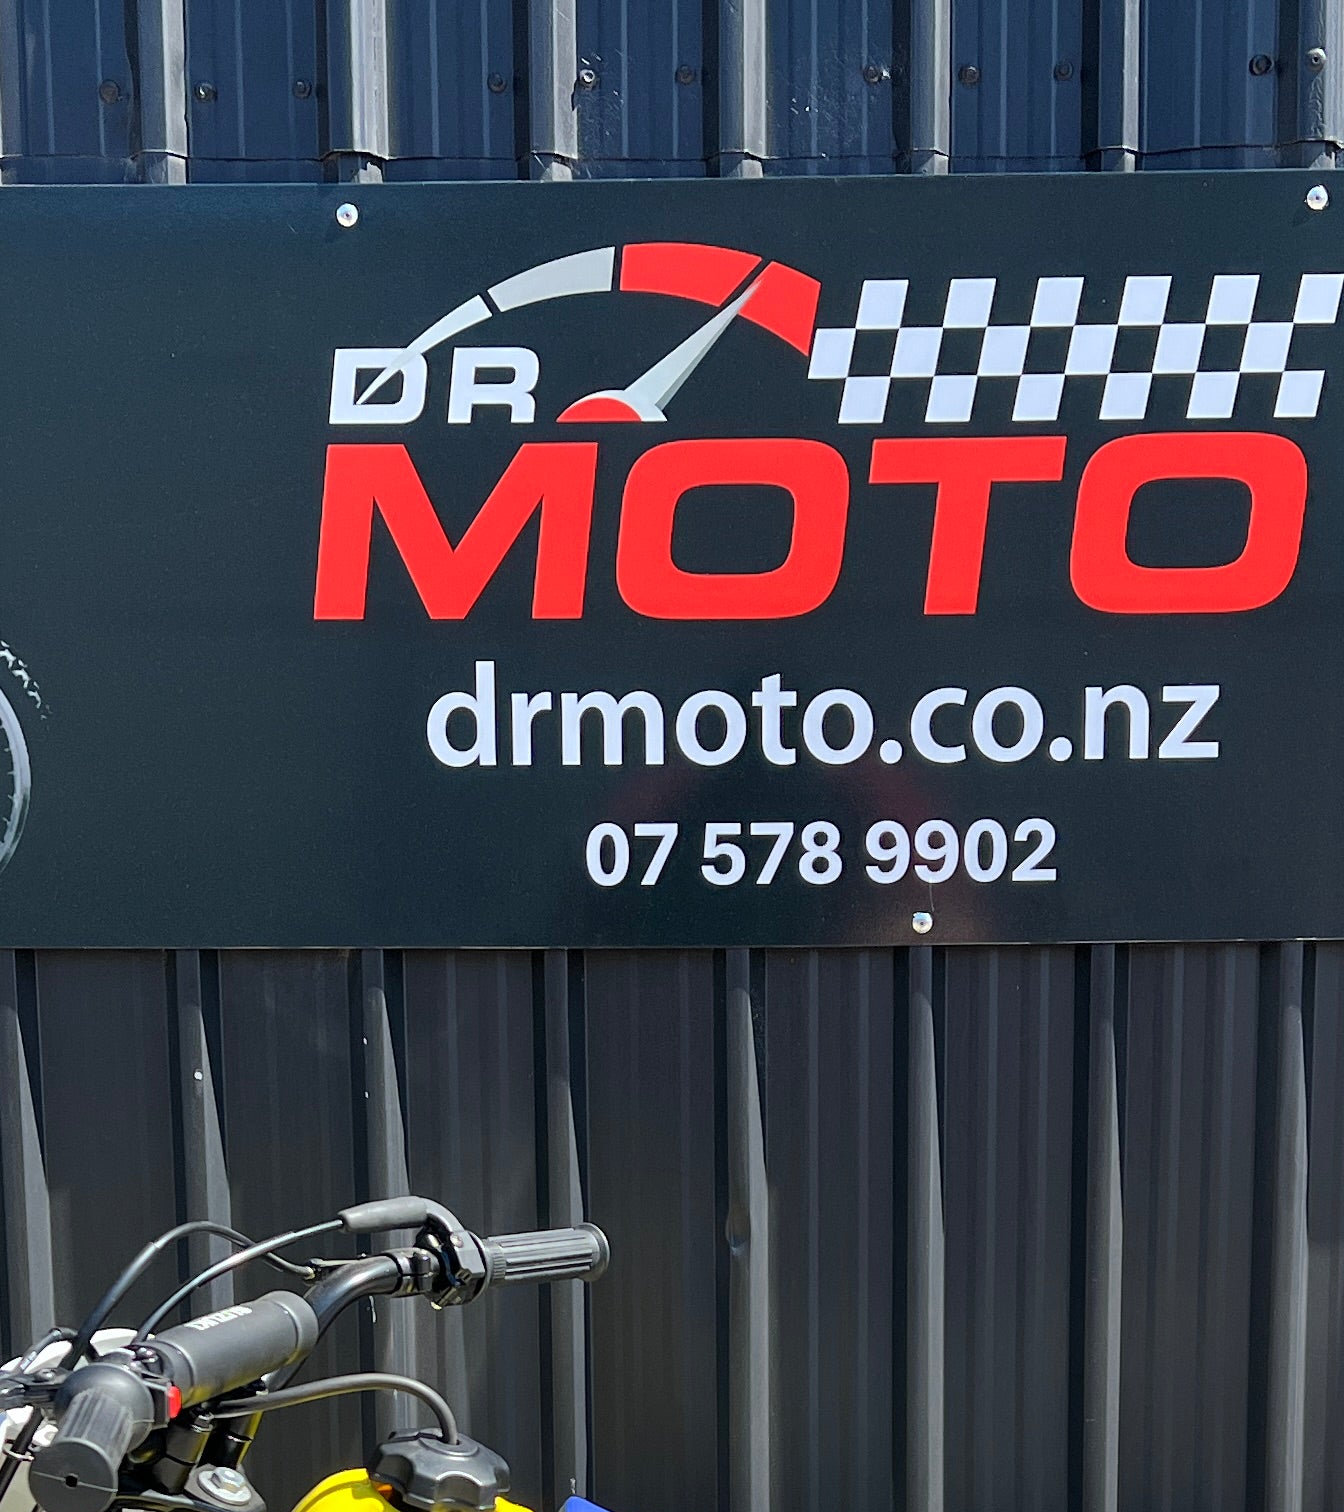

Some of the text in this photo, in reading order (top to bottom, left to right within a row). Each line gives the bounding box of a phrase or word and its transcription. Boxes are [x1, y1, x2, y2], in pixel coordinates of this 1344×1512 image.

[328, 346, 540, 425] DR
[314, 432, 1308, 620] MOTO
[427, 661, 1220, 767] drmoto.co.nz
[585, 818, 1057, 887] 07 578 9902
